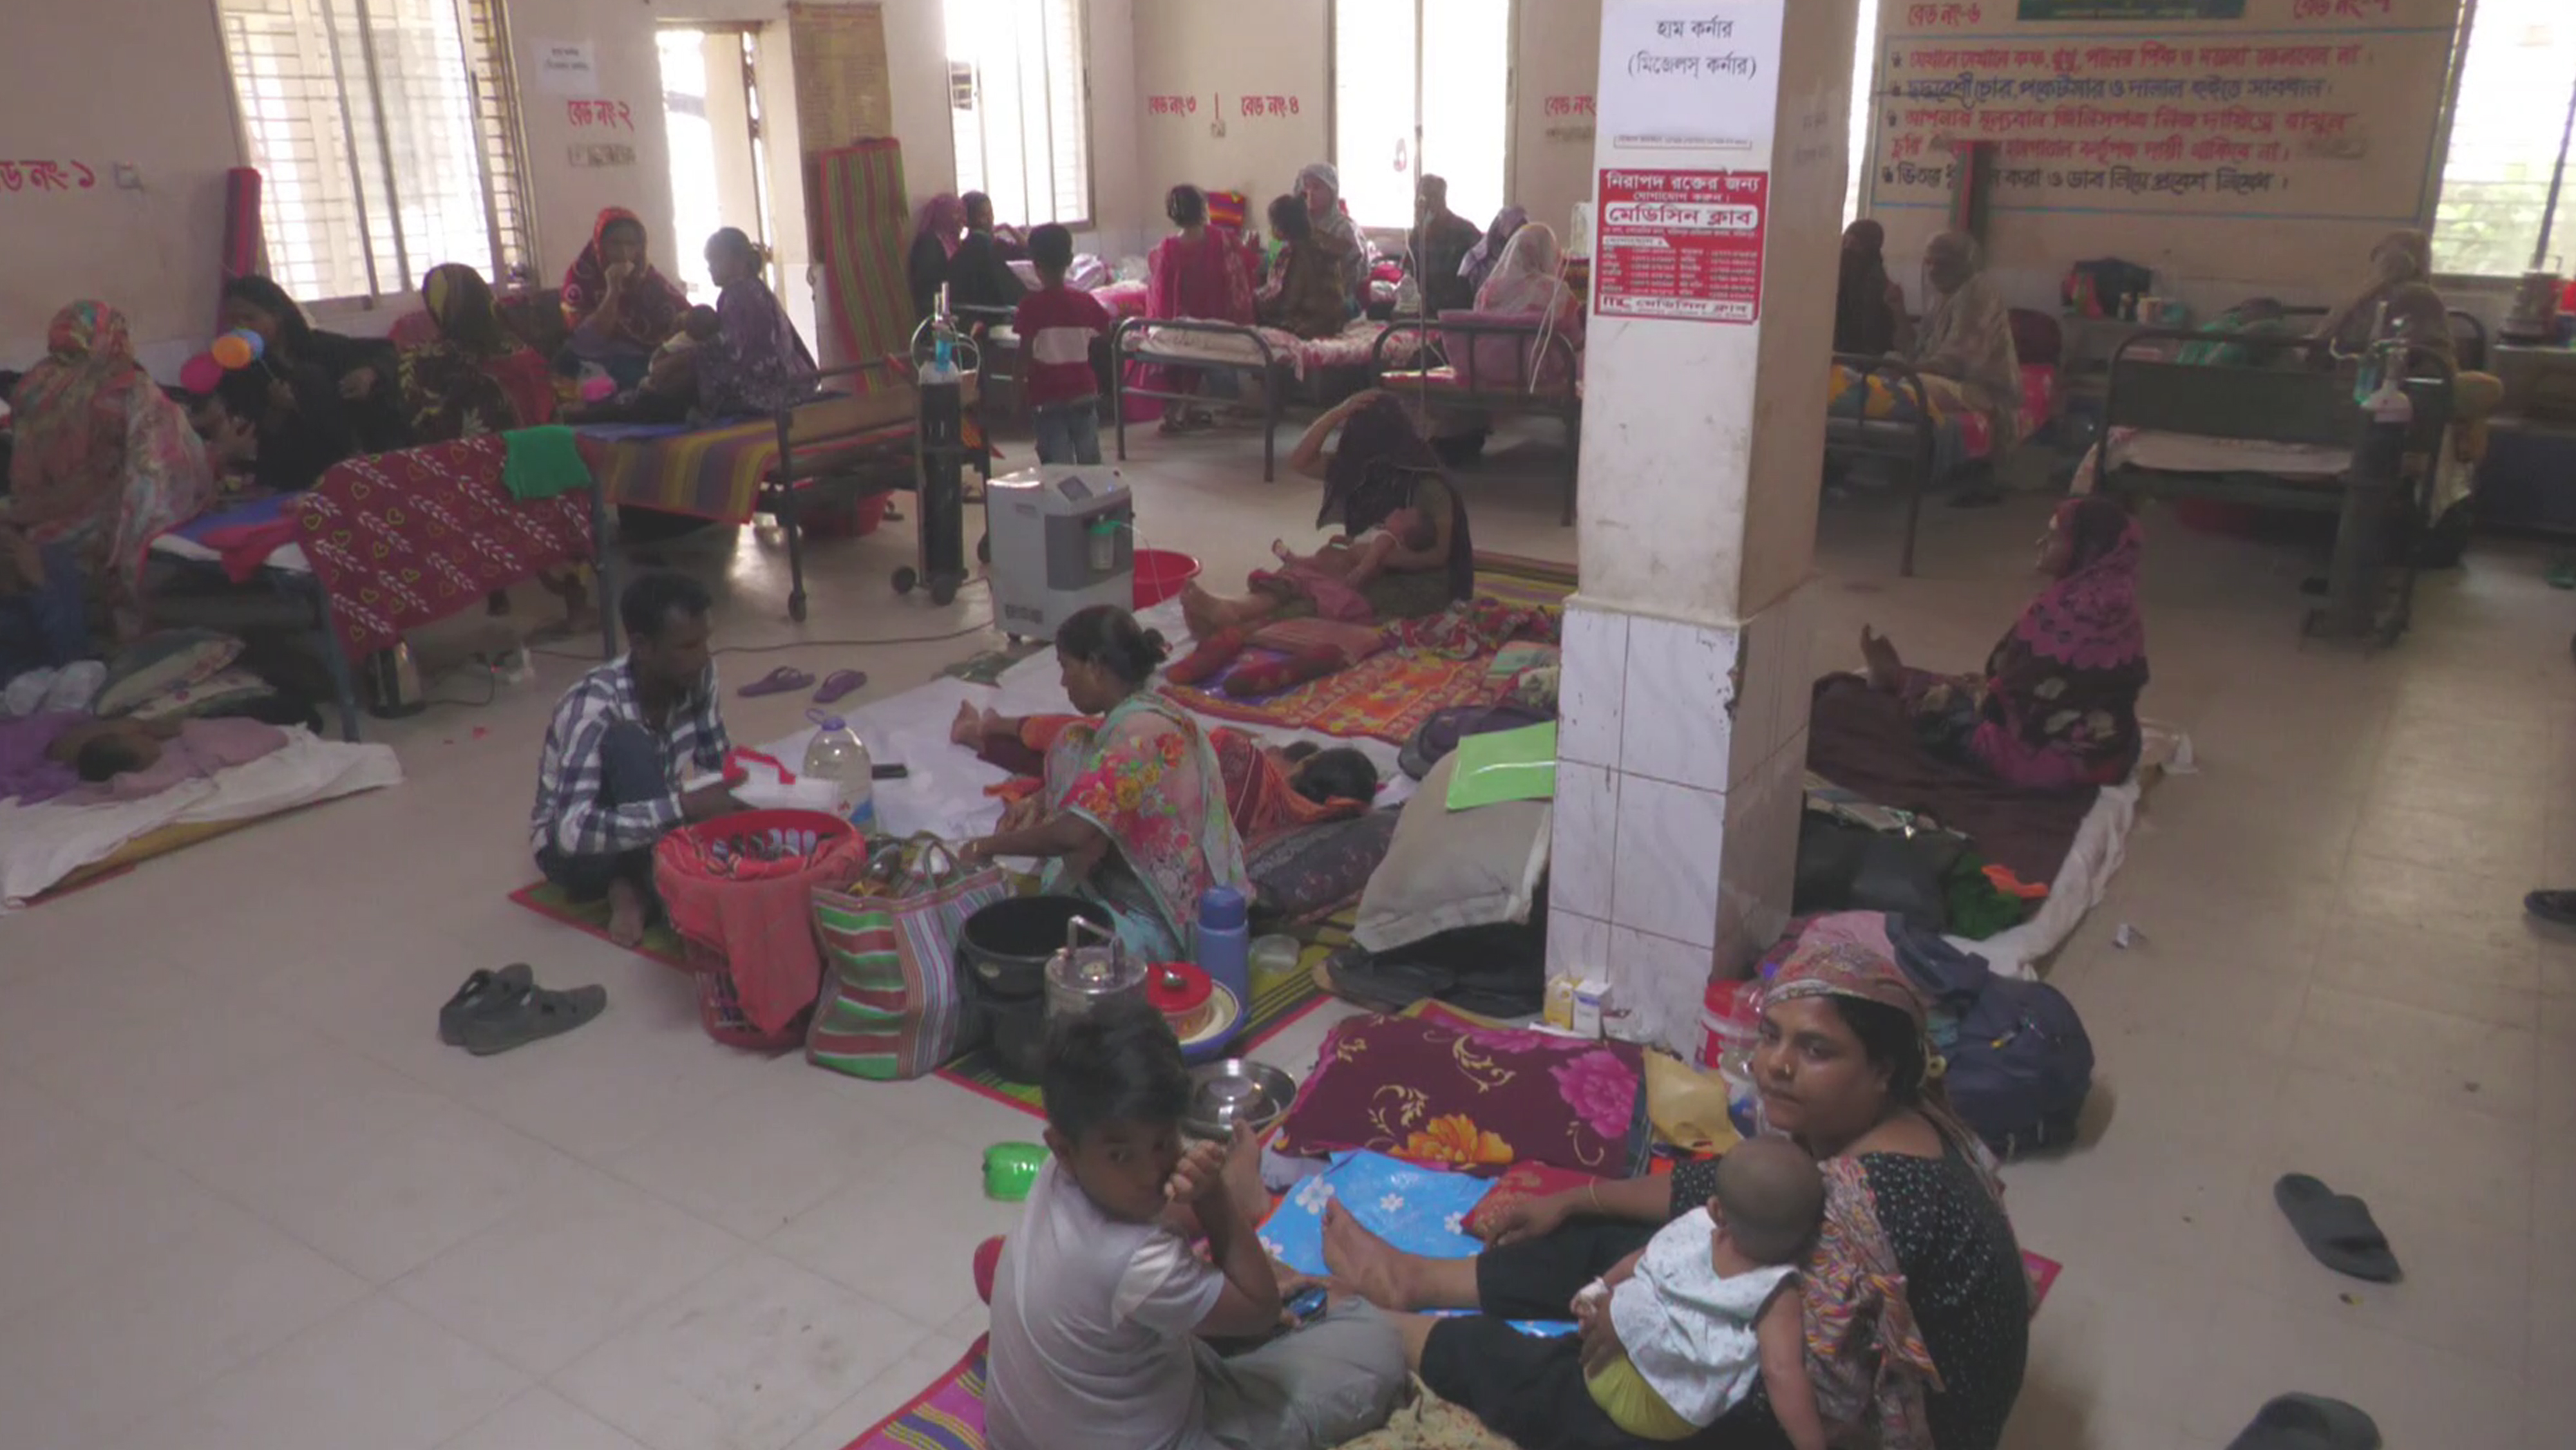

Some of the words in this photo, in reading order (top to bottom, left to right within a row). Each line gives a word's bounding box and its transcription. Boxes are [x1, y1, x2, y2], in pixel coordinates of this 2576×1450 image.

[1908, 4, 1938, 26] বেড
[1655, 20, 1686, 38] হাম
[1690, 14, 1735, 39] কর্নার
[1627, 50, 1701, 79] (মিজেলস্
[1705, 51, 1757, 80] কর্নার)
[2109, 79, 2125, 98] ও
[2127, 79, 2186, 99] দালাল
[567, 100, 593, 127] বেড
[1240, 96, 1264, 117] বেড
[1544, 95, 1571, 117] বেড
[1605, 171, 1665, 189] নিরাপদ
[1671, 174, 1720, 191] রক্তের
[1723, 176, 1761, 192] জন্য
[2047, 171, 2063, 187] ও
[1609, 203, 1701, 224] মেডিসিন
[1706, 209, 1754, 226] ক্লাব
